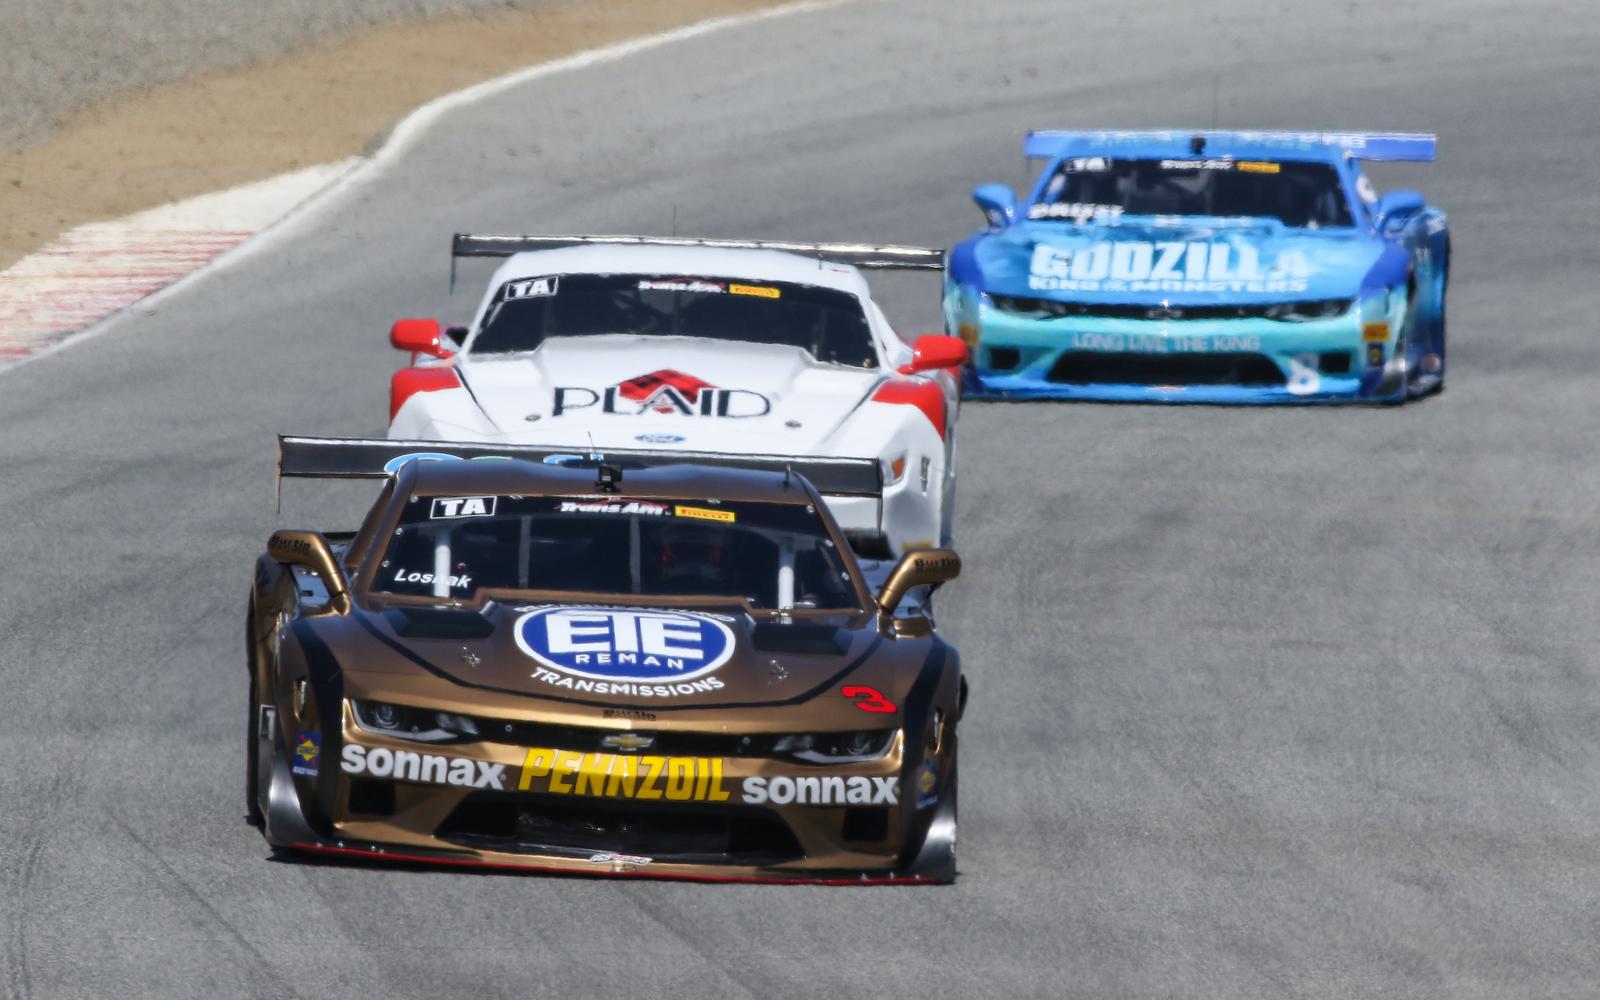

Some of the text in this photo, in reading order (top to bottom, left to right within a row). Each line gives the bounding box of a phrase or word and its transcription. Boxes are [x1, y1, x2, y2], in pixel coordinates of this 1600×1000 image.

[1030, 240, 1309, 279] GODZILLA
[511, 279, 550, 298] TA
[1073, 333, 1261, 351] LONG LIVE THE KING
[552, 385, 770, 418] PLAID
[440, 498, 487, 516] TA
[560, 502, 663, 516] Trans Am
[545, 611, 704, 660] ETE
[575, 653, 684, 670] REMAN
[529, 667, 726, 697] TRANSMISSIONS
[841, 685, 897, 714] 3
[341, 743, 505, 790] sonnax
[518, 747, 730, 801] PENNZOIL
[742, 776, 899, 804] sonnax
